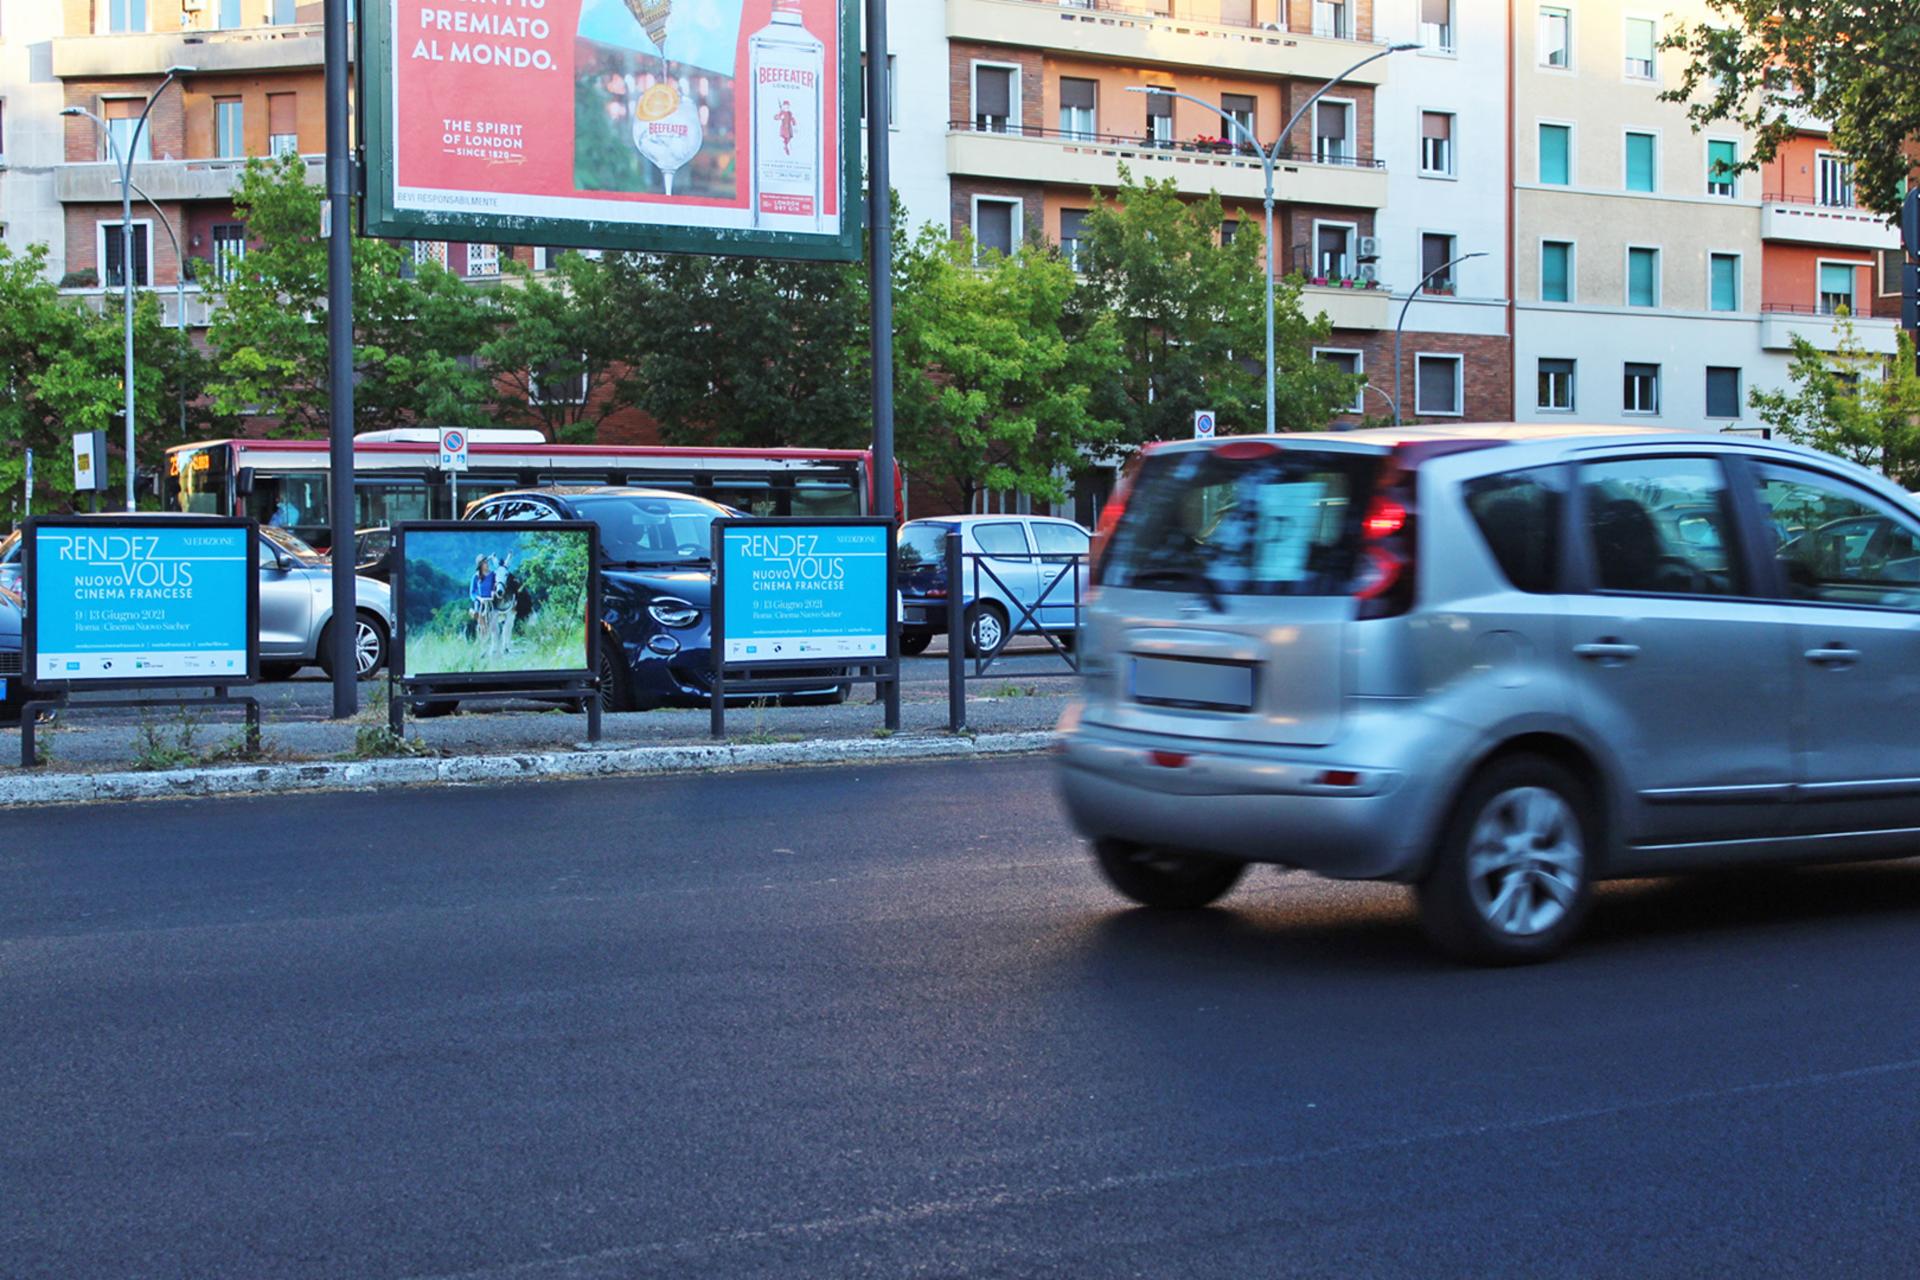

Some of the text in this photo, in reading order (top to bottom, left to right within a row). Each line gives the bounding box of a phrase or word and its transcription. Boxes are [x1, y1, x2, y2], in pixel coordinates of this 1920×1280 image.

[420, 8, 550, 40] PREMIATO
[411, 38, 557, 70] AL MONDO.
[759, 66, 814, 88] BEEFEATER
[443, 119, 523, 136] THE SPIRIT
[443, 134, 523, 149] OF LONDON
[456, 147, 509, 159] SINCE 1820
[58, 536, 161, 561] RENDEZ
[740, 535, 819, 557] RENDEZ
[118, 561, 193, 587] VOUS
[752, 570, 790, 579] NUOVO
[785, 557, 845, 579] VOUS
[74, 575, 123, 587] NUOVO
[752, 580, 845, 591] CINEMA FRANCESE
[74, 587, 193, 600] CINEMA FRANCESE
[773, 599, 804, 610] Giugno
[804, 599, 823, 609] 2021
[101, 608, 140, 622] Giugno
[141, 608, 165, 620] 2021
